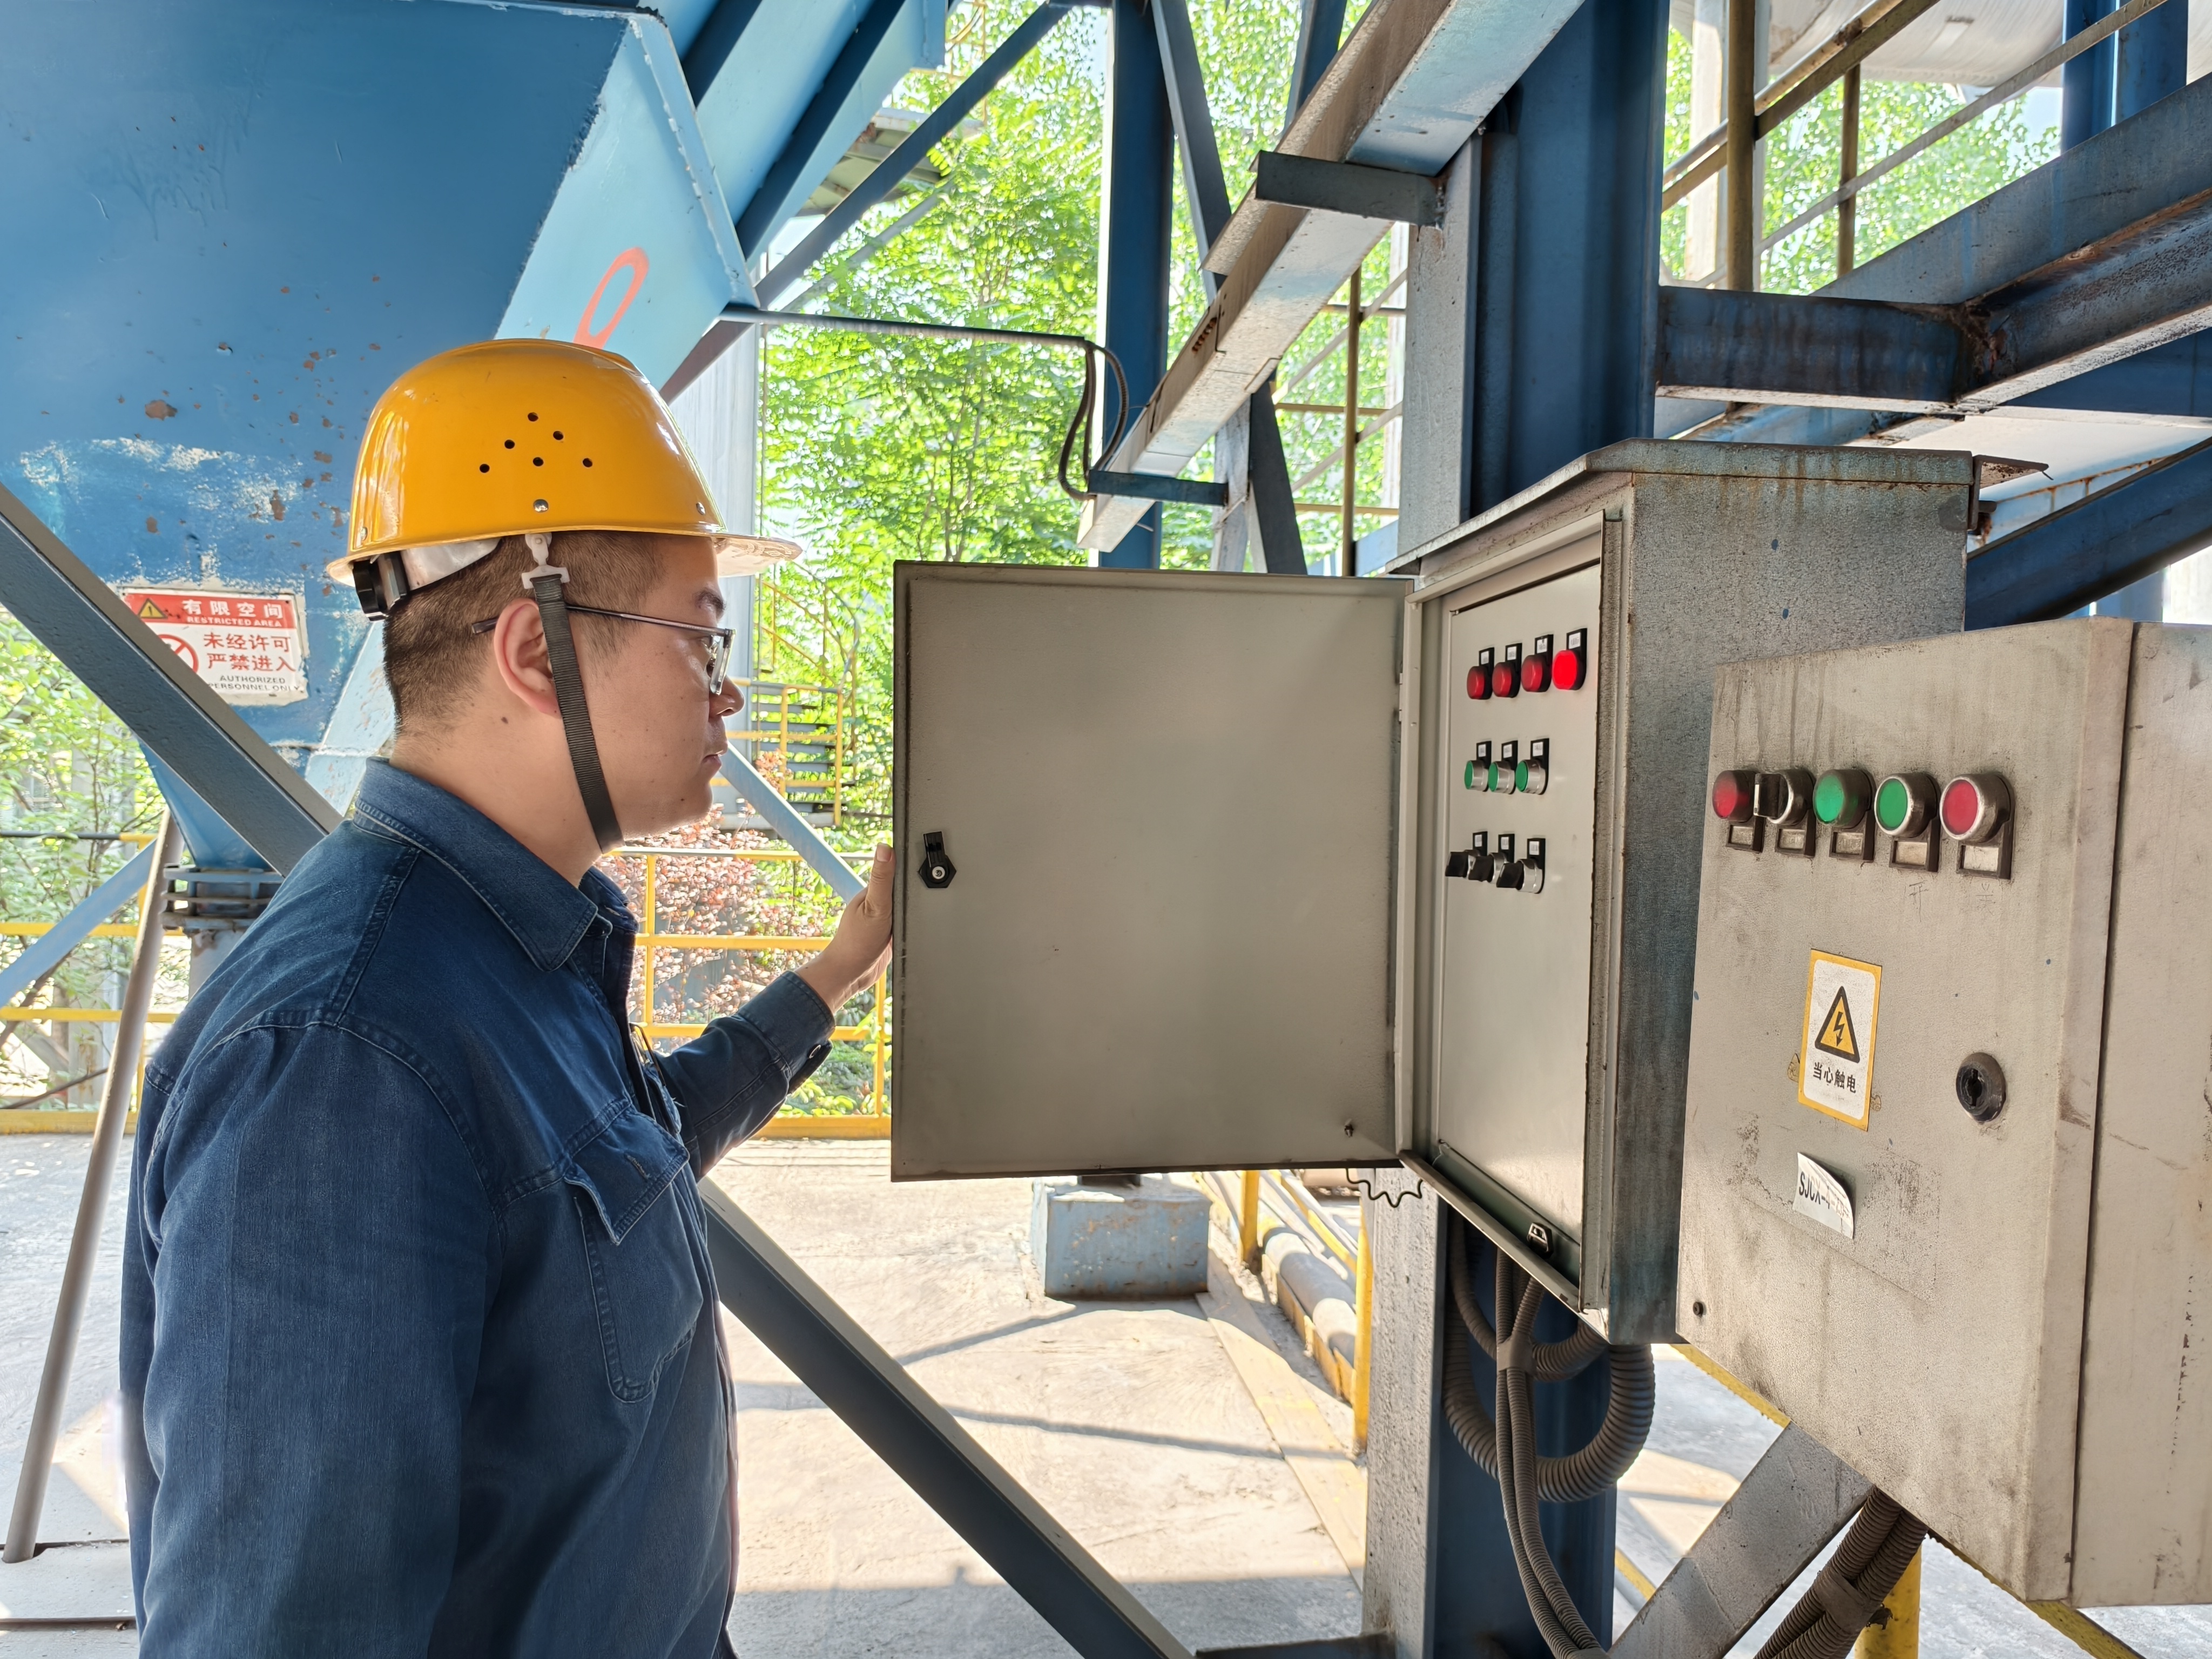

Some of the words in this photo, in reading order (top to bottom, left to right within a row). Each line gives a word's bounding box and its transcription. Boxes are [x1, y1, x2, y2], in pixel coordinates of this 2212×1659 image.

[182, 599, 283, 619] 有限空间
[187, 616, 252, 626] RESTRICTED
[254, 619, 282, 628] AREA
[204, 632, 291, 652] 未经许可
[207, 653, 296, 671] 严禁进入
[220, 676, 285, 684] AUTHORIZED
[1813, 1062, 1856, 1093] 当心触电
